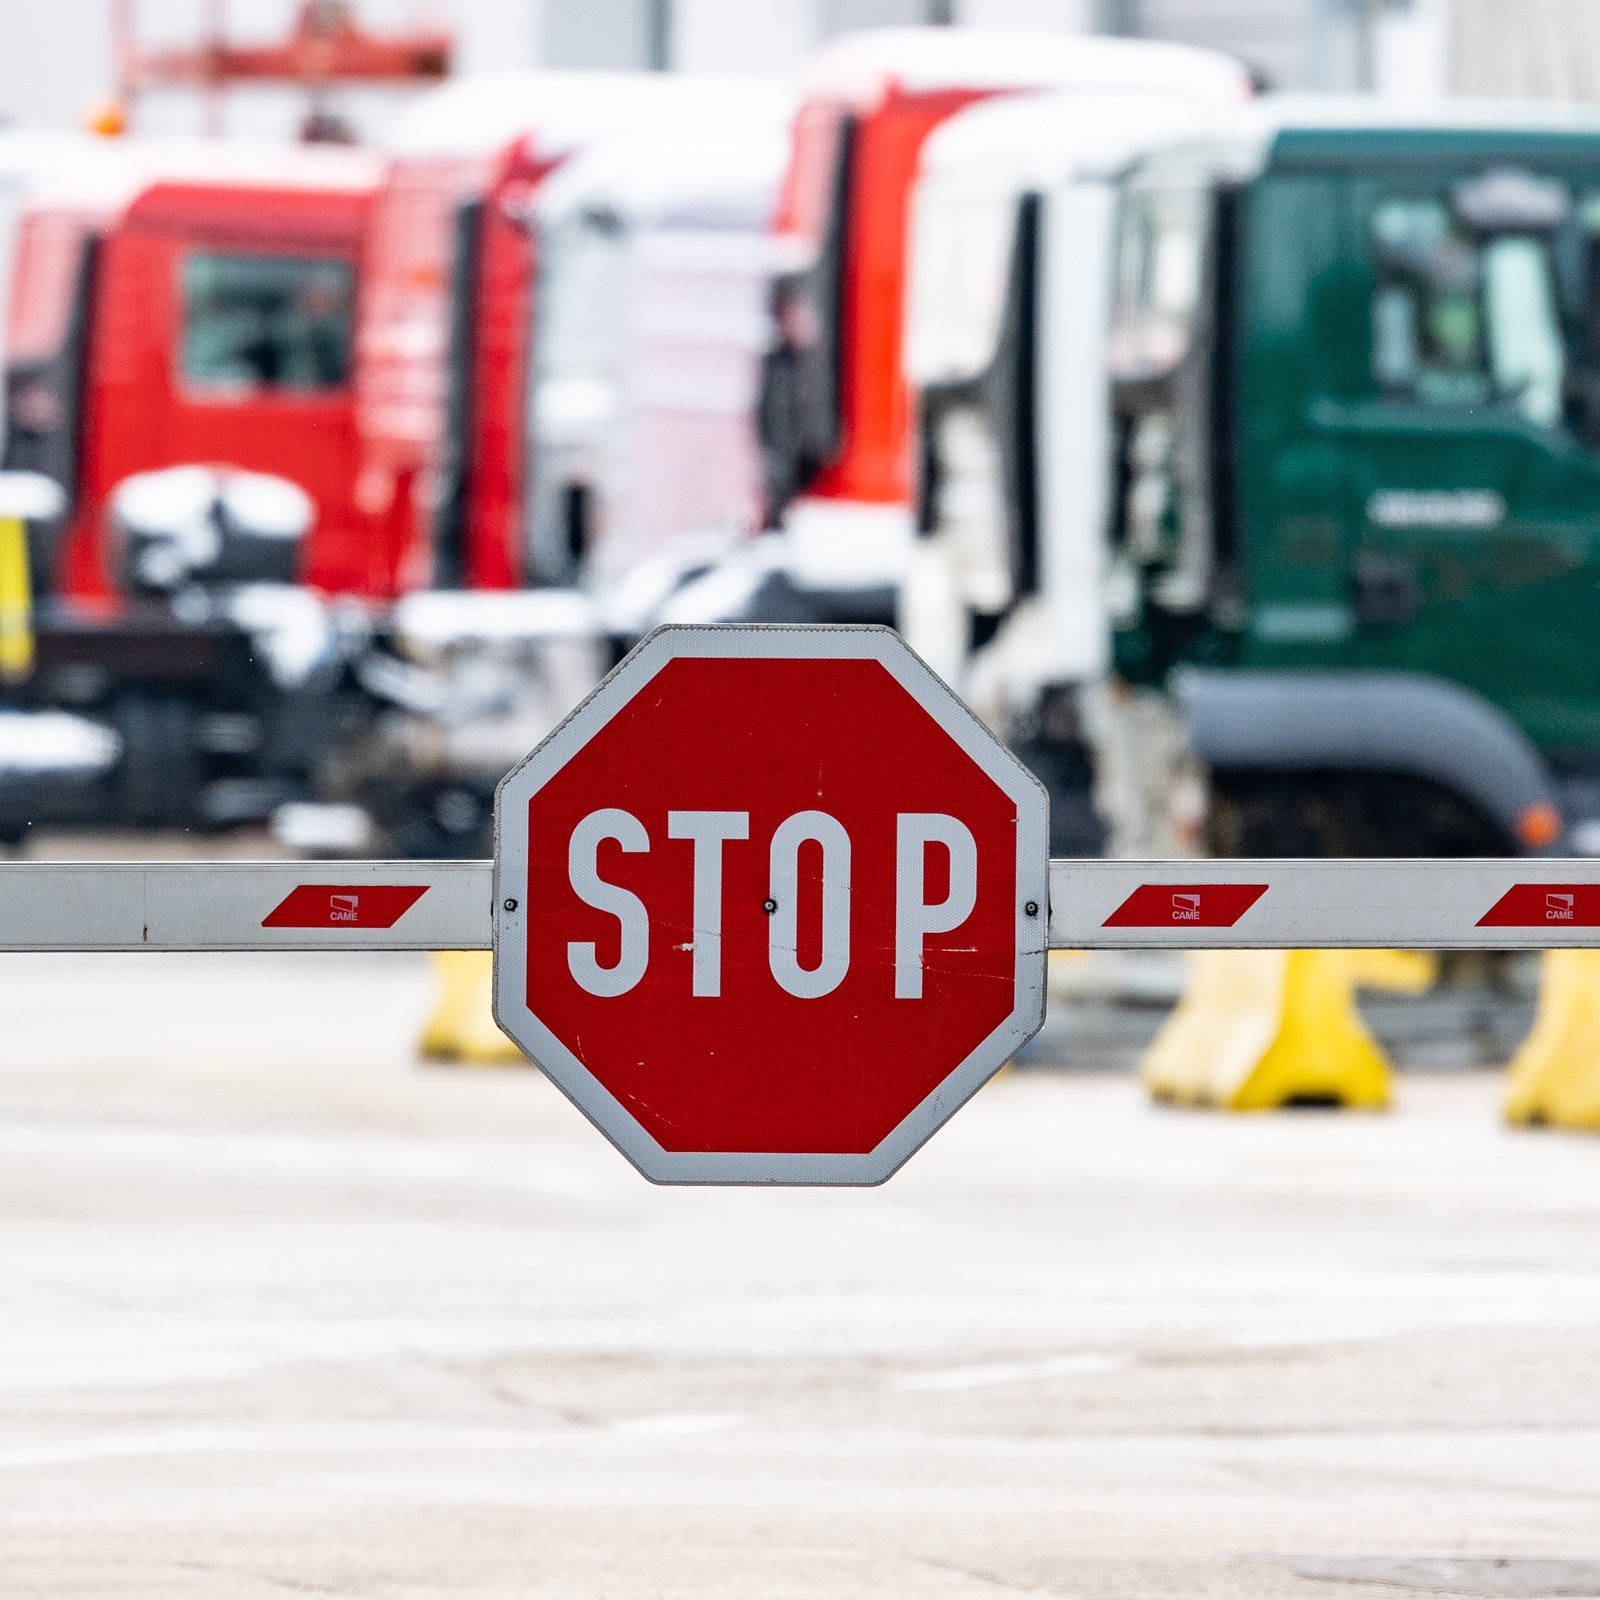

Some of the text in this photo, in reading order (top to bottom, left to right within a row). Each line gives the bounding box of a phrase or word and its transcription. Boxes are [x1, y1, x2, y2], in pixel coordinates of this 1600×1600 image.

[567, 808, 978, 999] STOP
[330, 912, 358, 921] CAME
[1172, 911, 1200, 920] CAME
[1546, 911, 1574, 920] CAME
